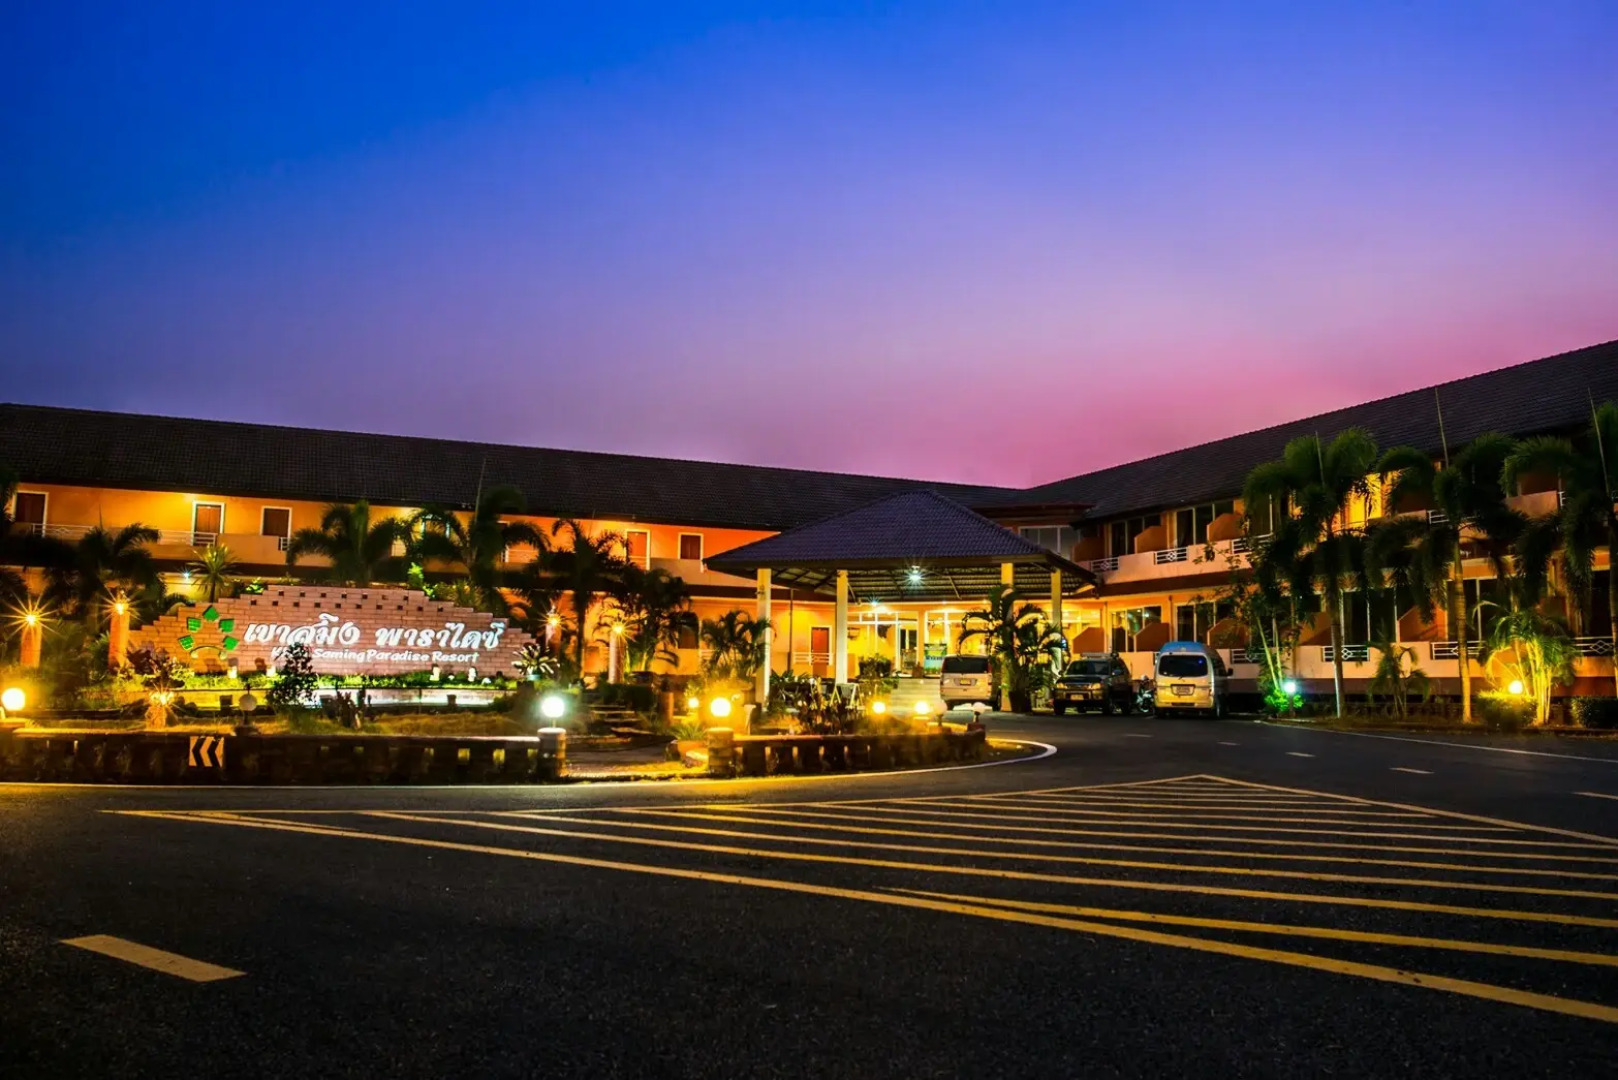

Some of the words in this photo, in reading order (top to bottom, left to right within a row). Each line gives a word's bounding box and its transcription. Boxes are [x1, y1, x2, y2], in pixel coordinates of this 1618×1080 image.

[313, 649, 365, 662] Saming
[366, 649, 429, 661] Paradise
[432, 651, 479, 662] Resort
